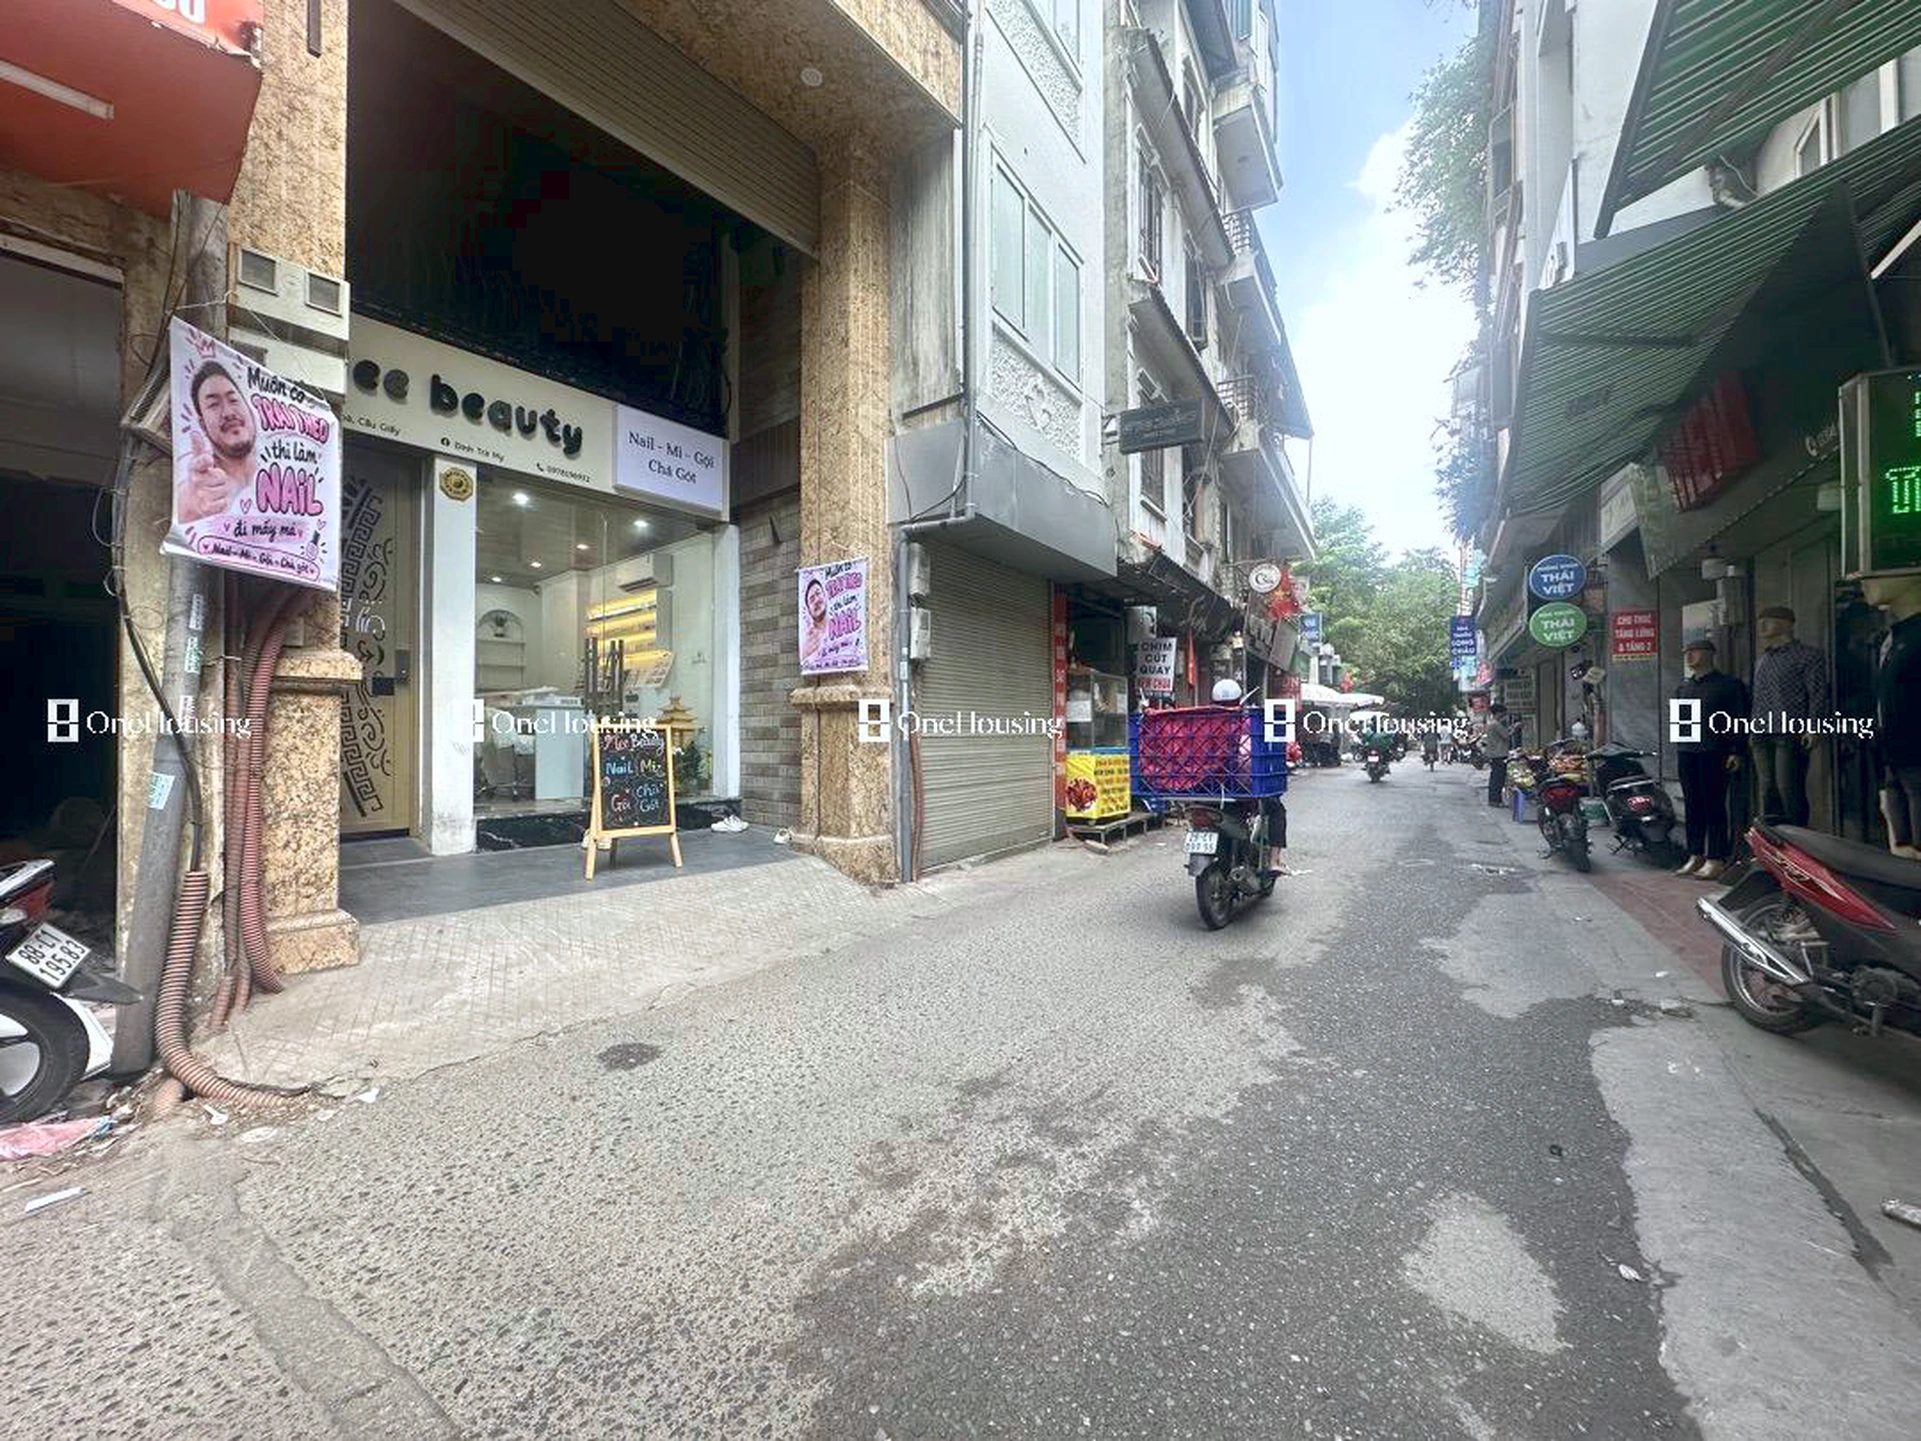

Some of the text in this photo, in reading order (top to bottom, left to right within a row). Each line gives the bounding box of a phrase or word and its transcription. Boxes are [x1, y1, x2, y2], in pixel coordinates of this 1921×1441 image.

[430, 374, 583, 455] beauty
[628, 430, 655, 450] Nail
[666, 442, 682, 458] Mi
[293, 442, 317, 464] làm
[1540, 569, 1575, 583] THÁI
[1542, 582, 1575, 595] VIỆT
[1141, 641, 1172, 651] CHIM
[1145, 652, 1167, 662] CÚT
[1140, 665, 1171, 675] QUAY
[39, 940, 86, 981] 195.83
